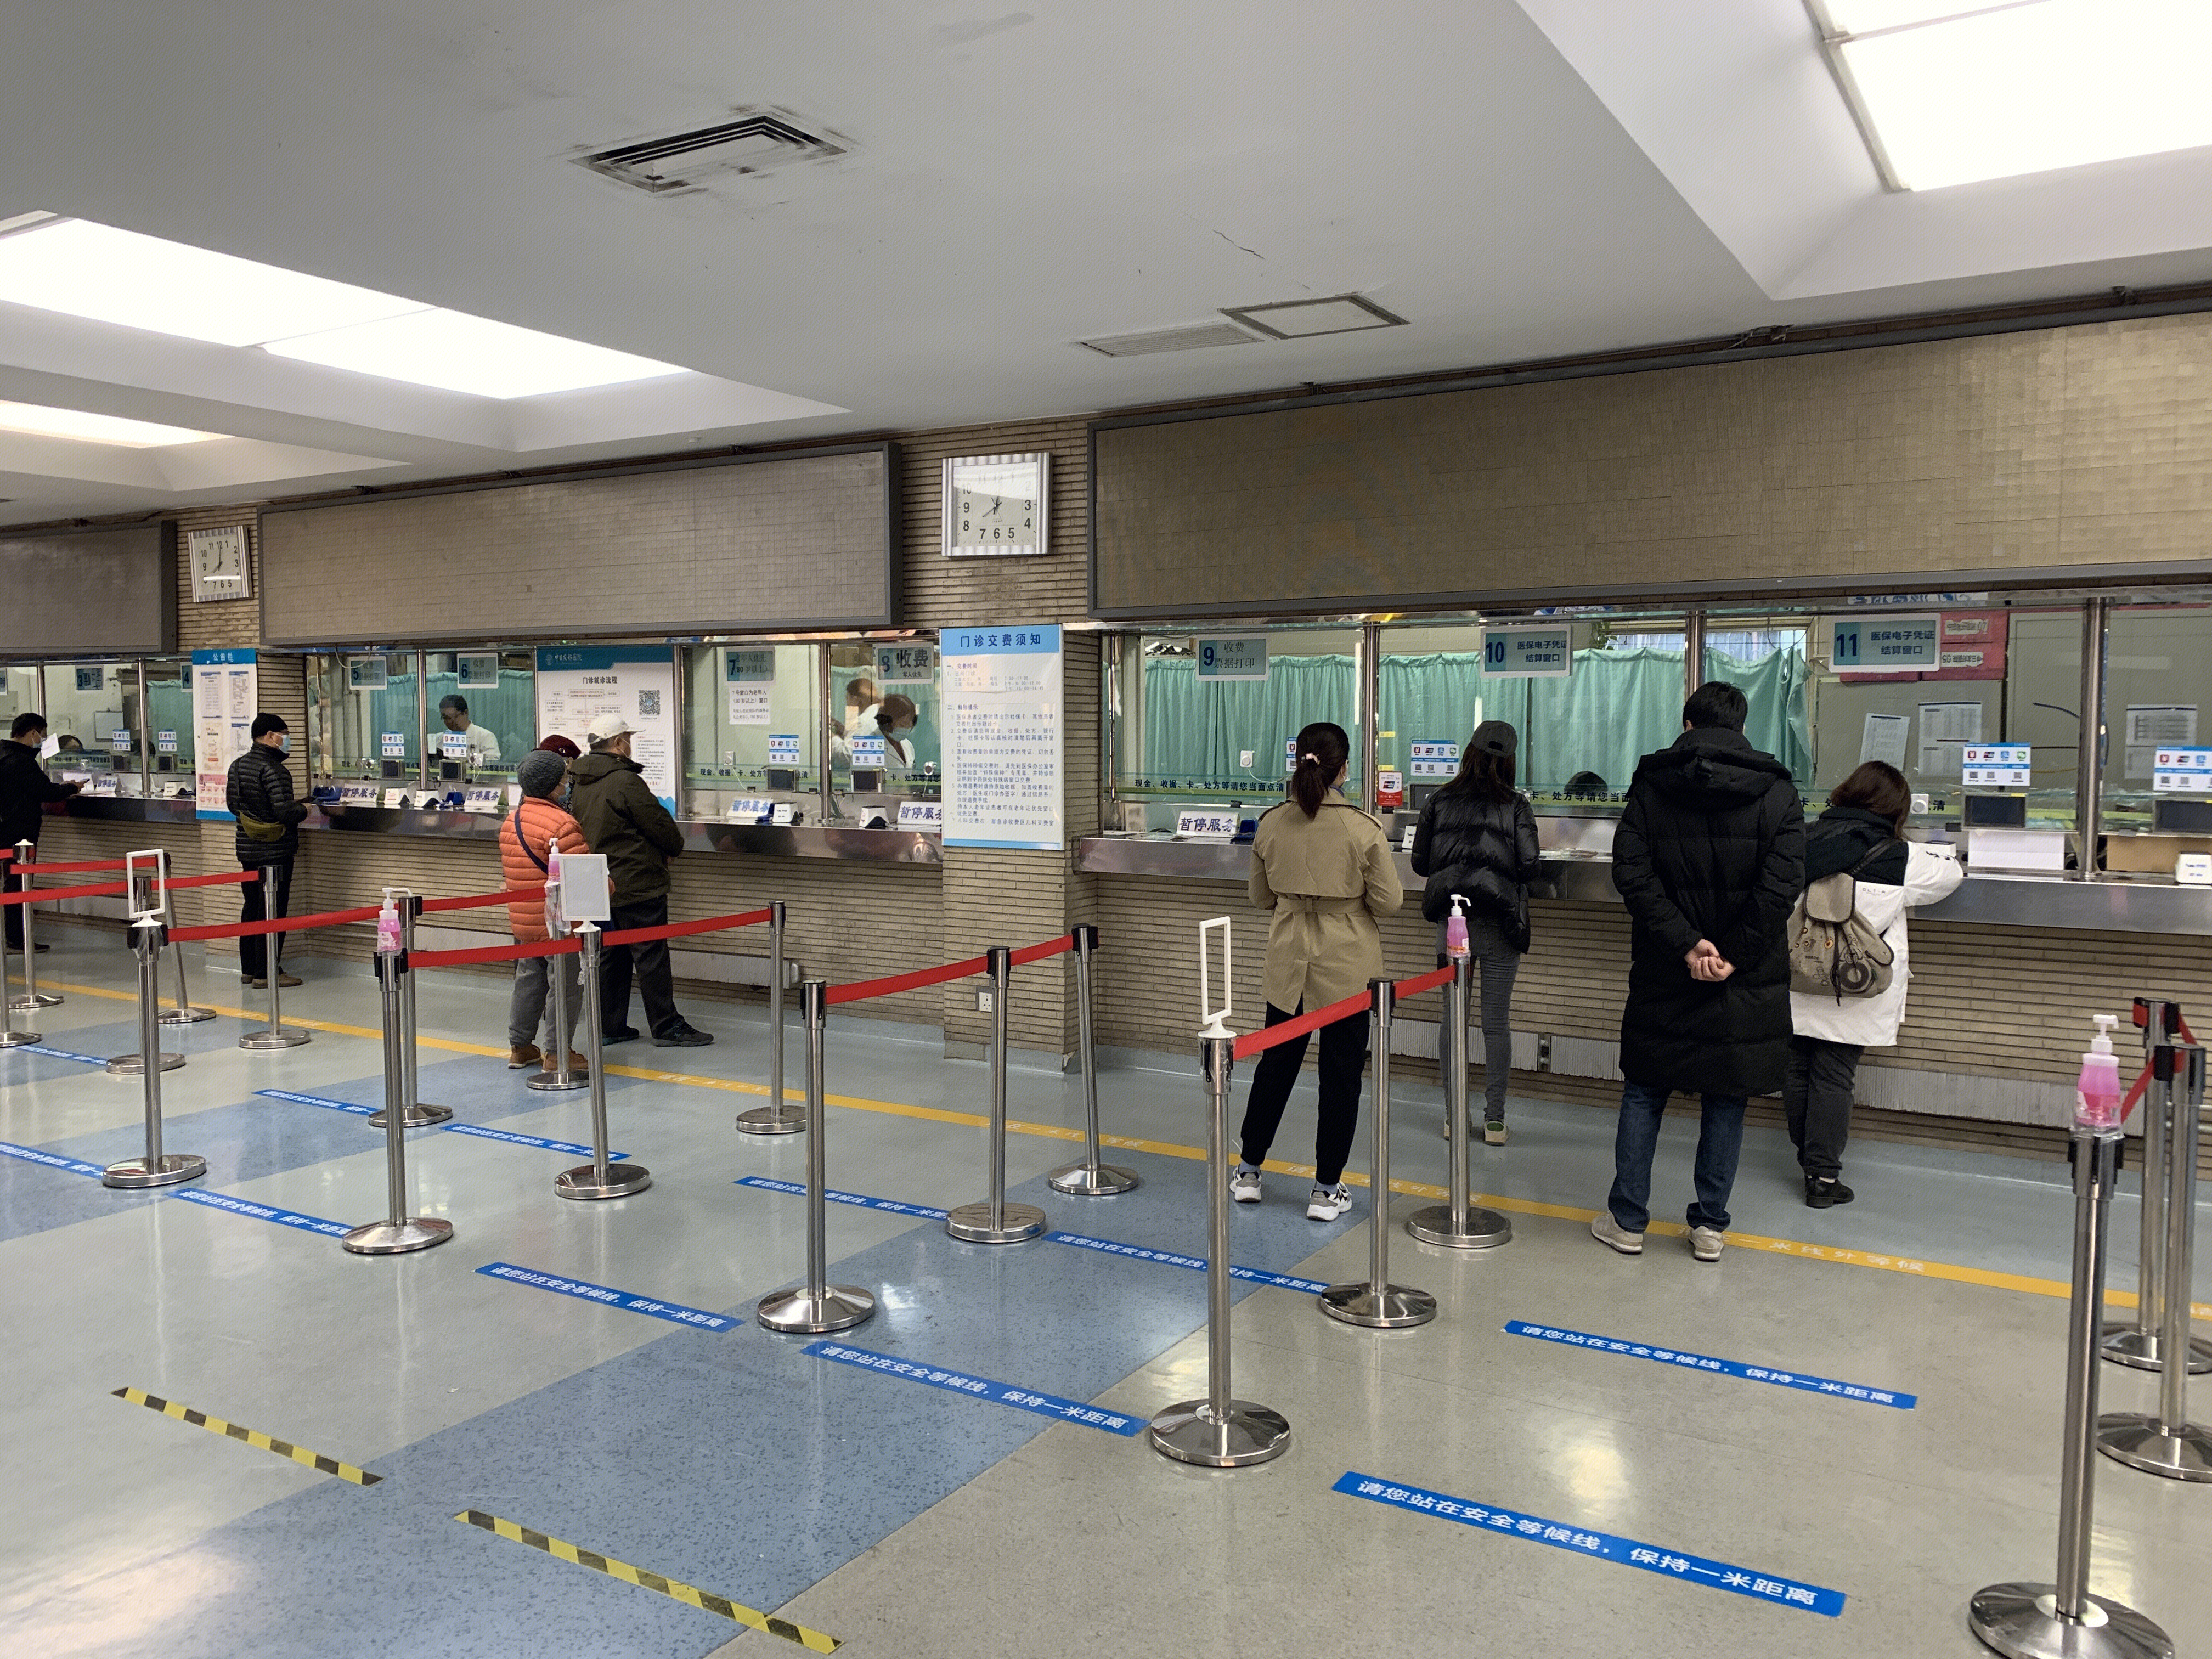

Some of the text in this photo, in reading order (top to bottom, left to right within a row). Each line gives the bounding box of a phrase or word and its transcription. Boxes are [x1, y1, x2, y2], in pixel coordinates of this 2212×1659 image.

[963, 502, 970, 513] 9
[1024, 499, 1031, 511] 3
[963, 520, 969, 531] 8
[1024, 518, 1031, 529] 4
[979, 528, 986, 539] 7
[994, 528, 1000, 539] 6
[1008, 527, 1014, 539] 5
[216, 541, 223, 549] 12
[225, 540, 229, 548] 1
[234, 545, 238, 554] 2
[201, 549, 207, 557] 10
[202, 562, 207, 571] 9
[234, 559, 239, 567] 3
[212, 581, 217, 589] 7
[220, 580, 224, 588] 6
[228, 579, 232, 588] 5
[961, 633, 1041, 647] 门诊交费须知
[1871, 630, 1936, 641] 医保电子凭证
[1224, 641, 1244, 653] 收费
[1517, 640, 1567, 650] 医保电子凭证
[1837, 633, 1857, 657] 11
[1881, 646, 1923, 655] 结算窗口
[896, 648, 928, 668] 收费
[1203, 646, 1214, 667] 9
[1486, 641, 1505, 663] 10
[1525, 653, 1560, 663] 结算窗口
[729, 659, 736, 675] 7
[882, 655, 890, 673] 8
[1214, 657, 1255, 669] 票据打印
[353, 667, 359, 681] 5
[461, 664, 467, 679] 6
[184, 672, 190, 684] 4
[1135, 779, 1284, 792] 现金、收据、卡、处方等请您当面点清
[732, 799, 769, 813] 暂停服务
[1180, 817, 1235, 833] 暂停服务
[490, 1266, 726, 1327] 请您站在安全等候线，保持一米距离
[1522, 1325, 1895, 1404] 请您站在安全等候线，保持一米距离
[820, 1345, 1128, 1430] 请您站在安全等候线，保持一米距离
[1357, 1480, 1818, 1607] 请您站在安全等候线，保持一米距离
